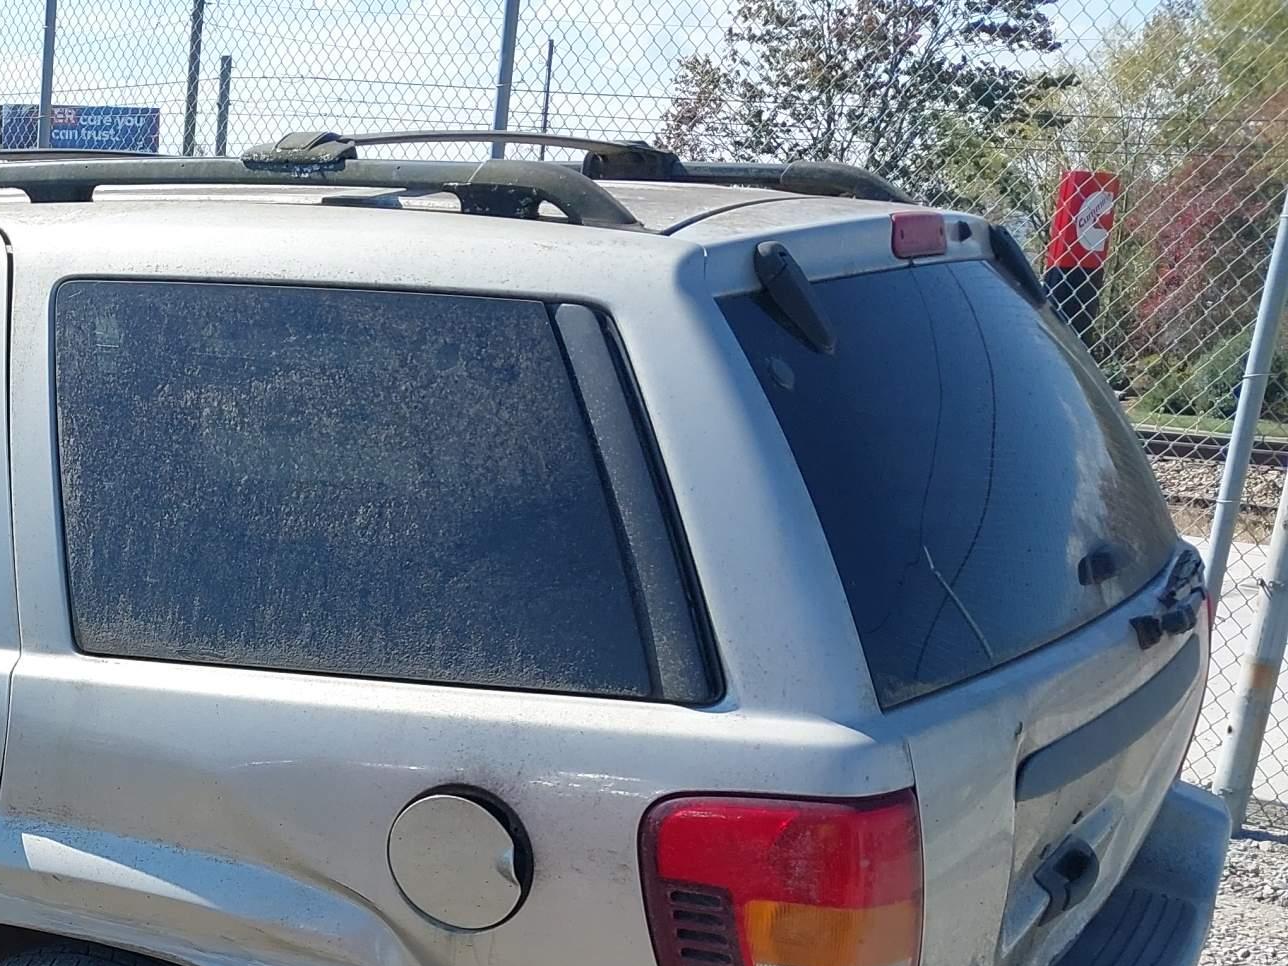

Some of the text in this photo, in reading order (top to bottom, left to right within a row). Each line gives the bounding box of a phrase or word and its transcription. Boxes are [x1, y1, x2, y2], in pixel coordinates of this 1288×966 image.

[80, 114, 112, 126] care
[116, 114, 144, 130] you
[52, 128, 78, 140] can
